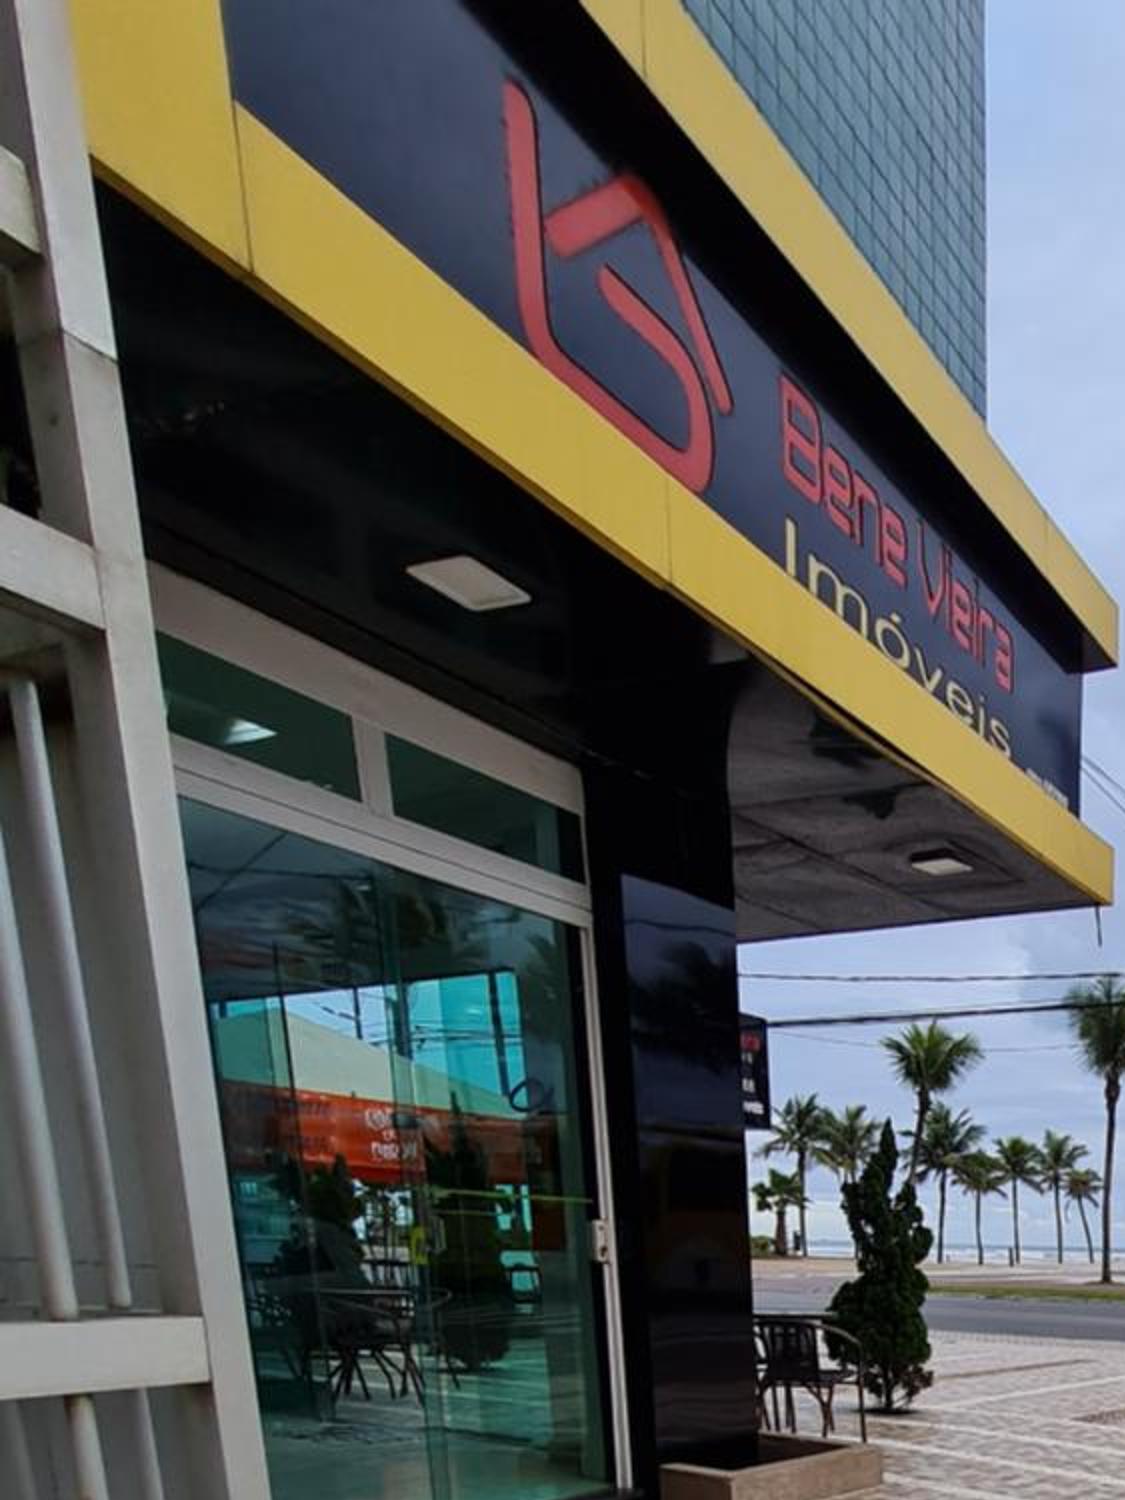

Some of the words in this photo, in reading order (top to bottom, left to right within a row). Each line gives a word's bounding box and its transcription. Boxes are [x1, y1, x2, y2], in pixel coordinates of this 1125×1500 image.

[778, 372, 908, 594] Bene
[914, 514, 1016, 697] Vieira
[784, 516, 1013, 760] Imóveis
